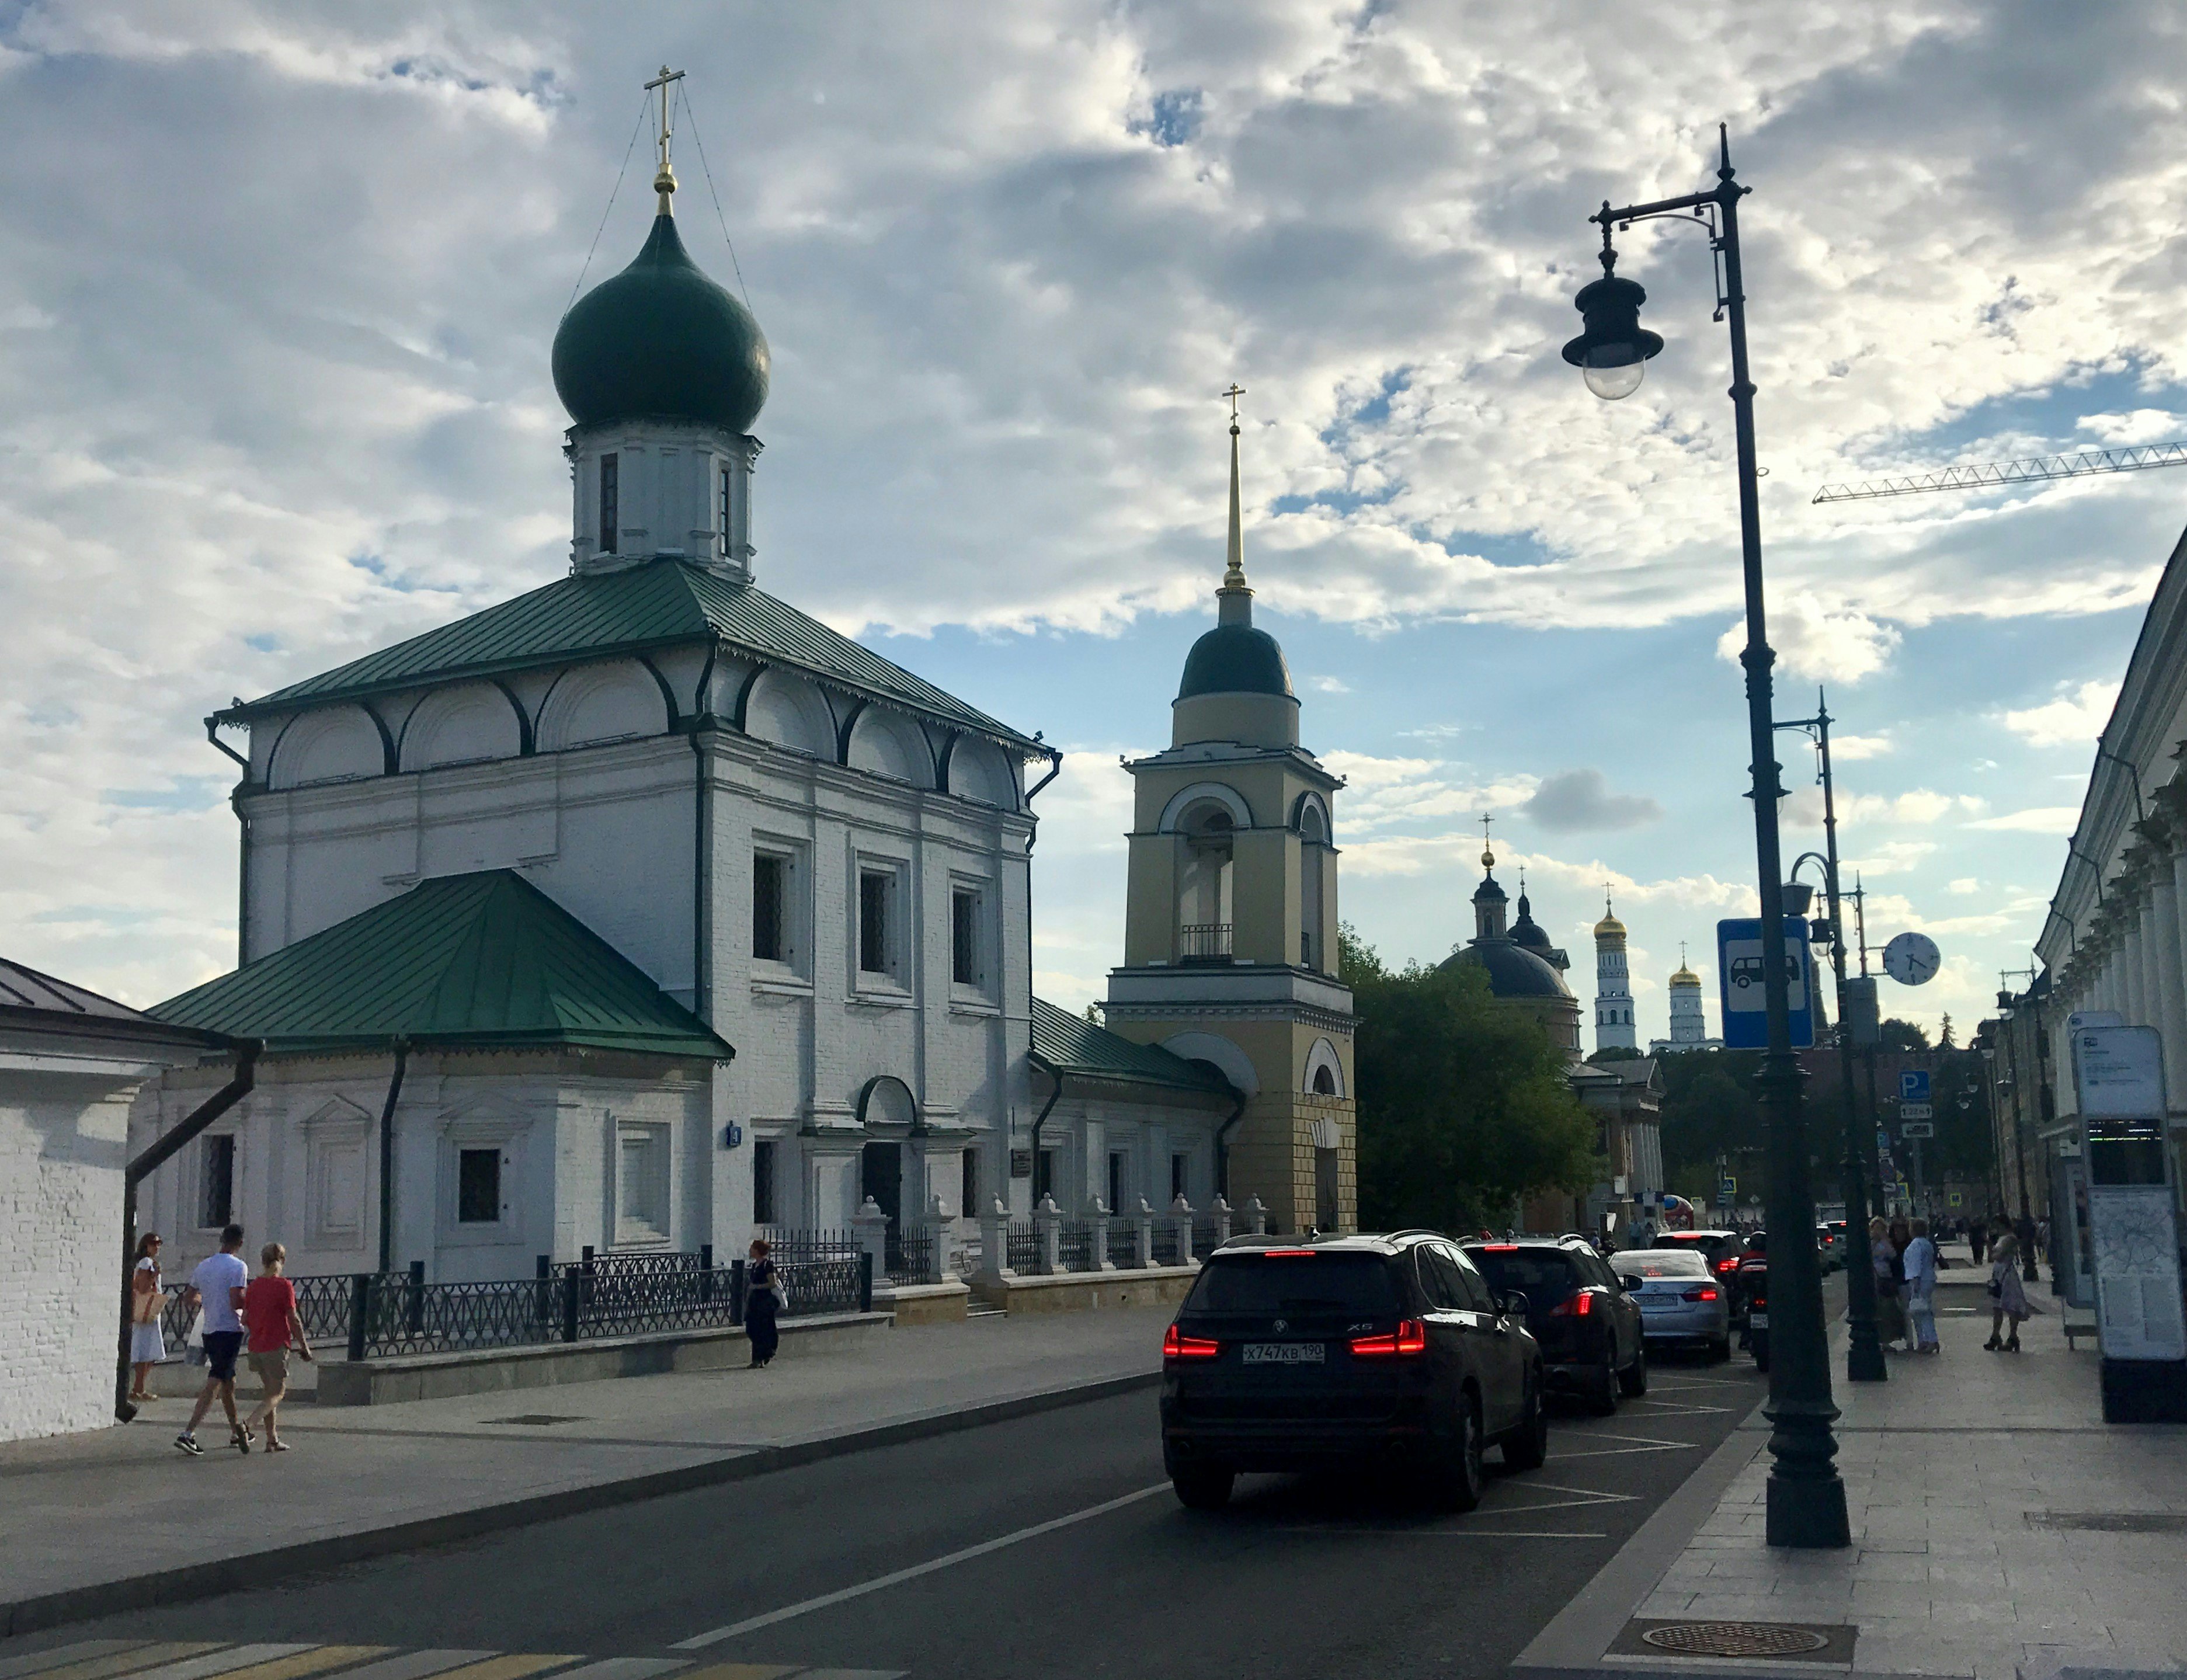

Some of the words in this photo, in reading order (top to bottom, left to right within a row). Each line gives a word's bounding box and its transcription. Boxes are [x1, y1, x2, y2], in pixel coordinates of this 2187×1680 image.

[1901, 1073, 1919, 1097] P
[1347, 1323, 1373, 1331] X5
[1302, 1345, 1321, 1355] 190
